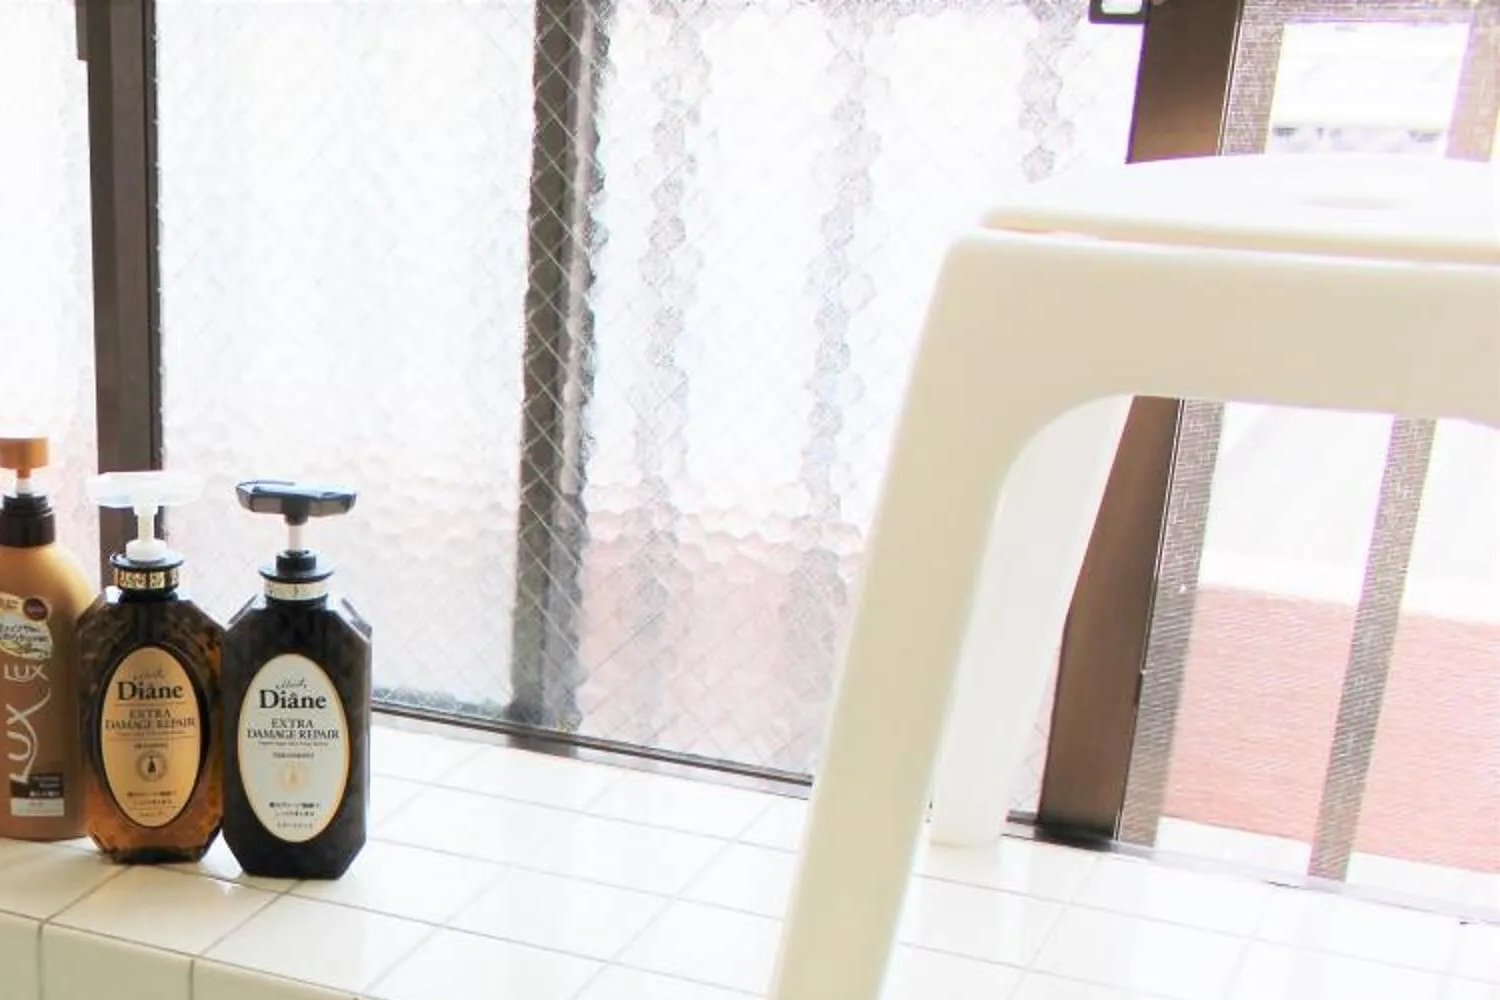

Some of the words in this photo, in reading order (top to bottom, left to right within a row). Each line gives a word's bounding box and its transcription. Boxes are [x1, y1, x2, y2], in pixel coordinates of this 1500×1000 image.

[4, 664, 49, 682] LUX
[271, 718, 314, 729] EXTRA
[6, 690, 51, 783] LUX
[299, 729, 339, 740] REPAIR
